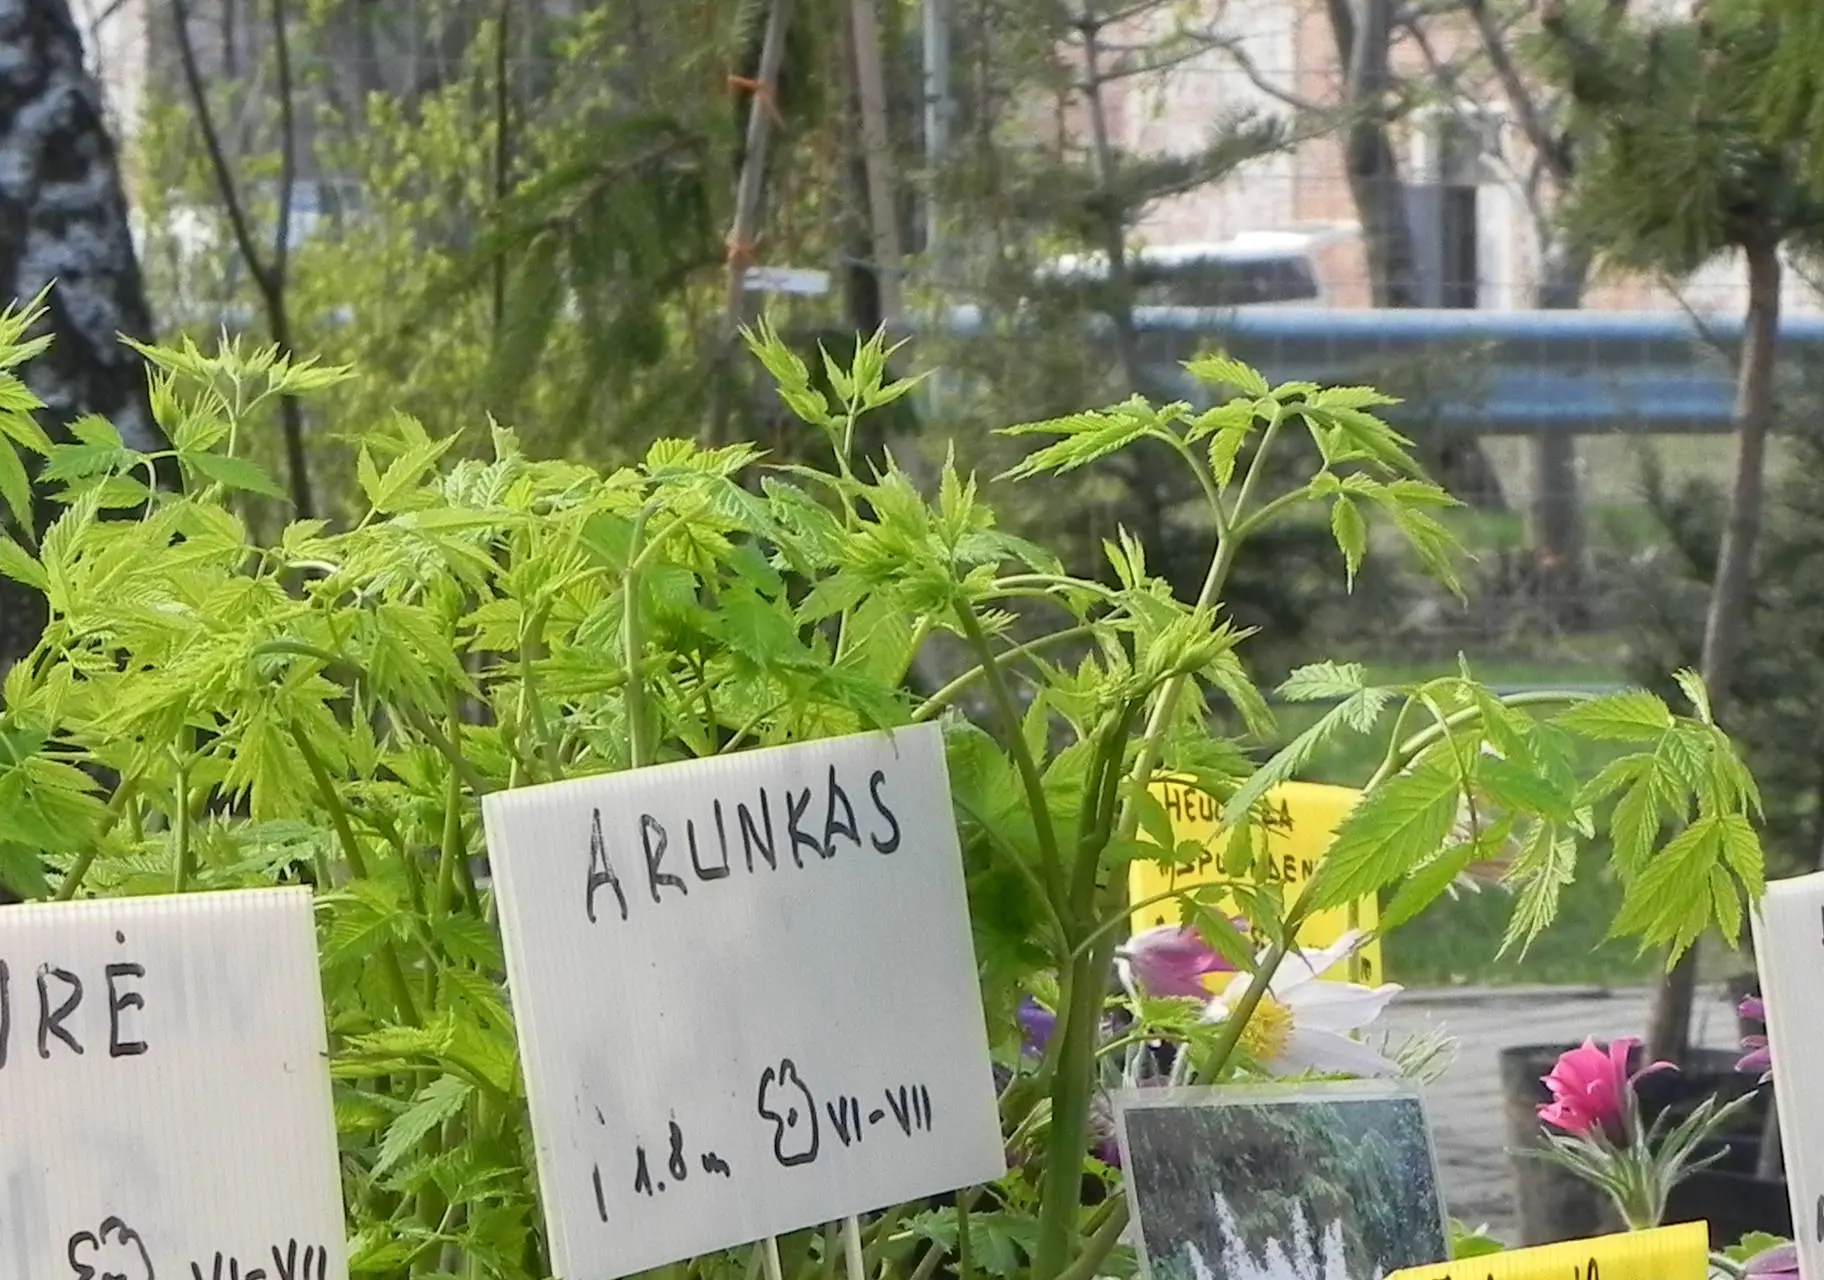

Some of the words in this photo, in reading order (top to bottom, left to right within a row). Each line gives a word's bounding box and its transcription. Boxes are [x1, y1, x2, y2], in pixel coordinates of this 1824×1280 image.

[586, 764, 900, 923] ARUNKAS
[0, 931, 148, 1070] RĖ
[826, 1084, 932, 1147] VI-VII
